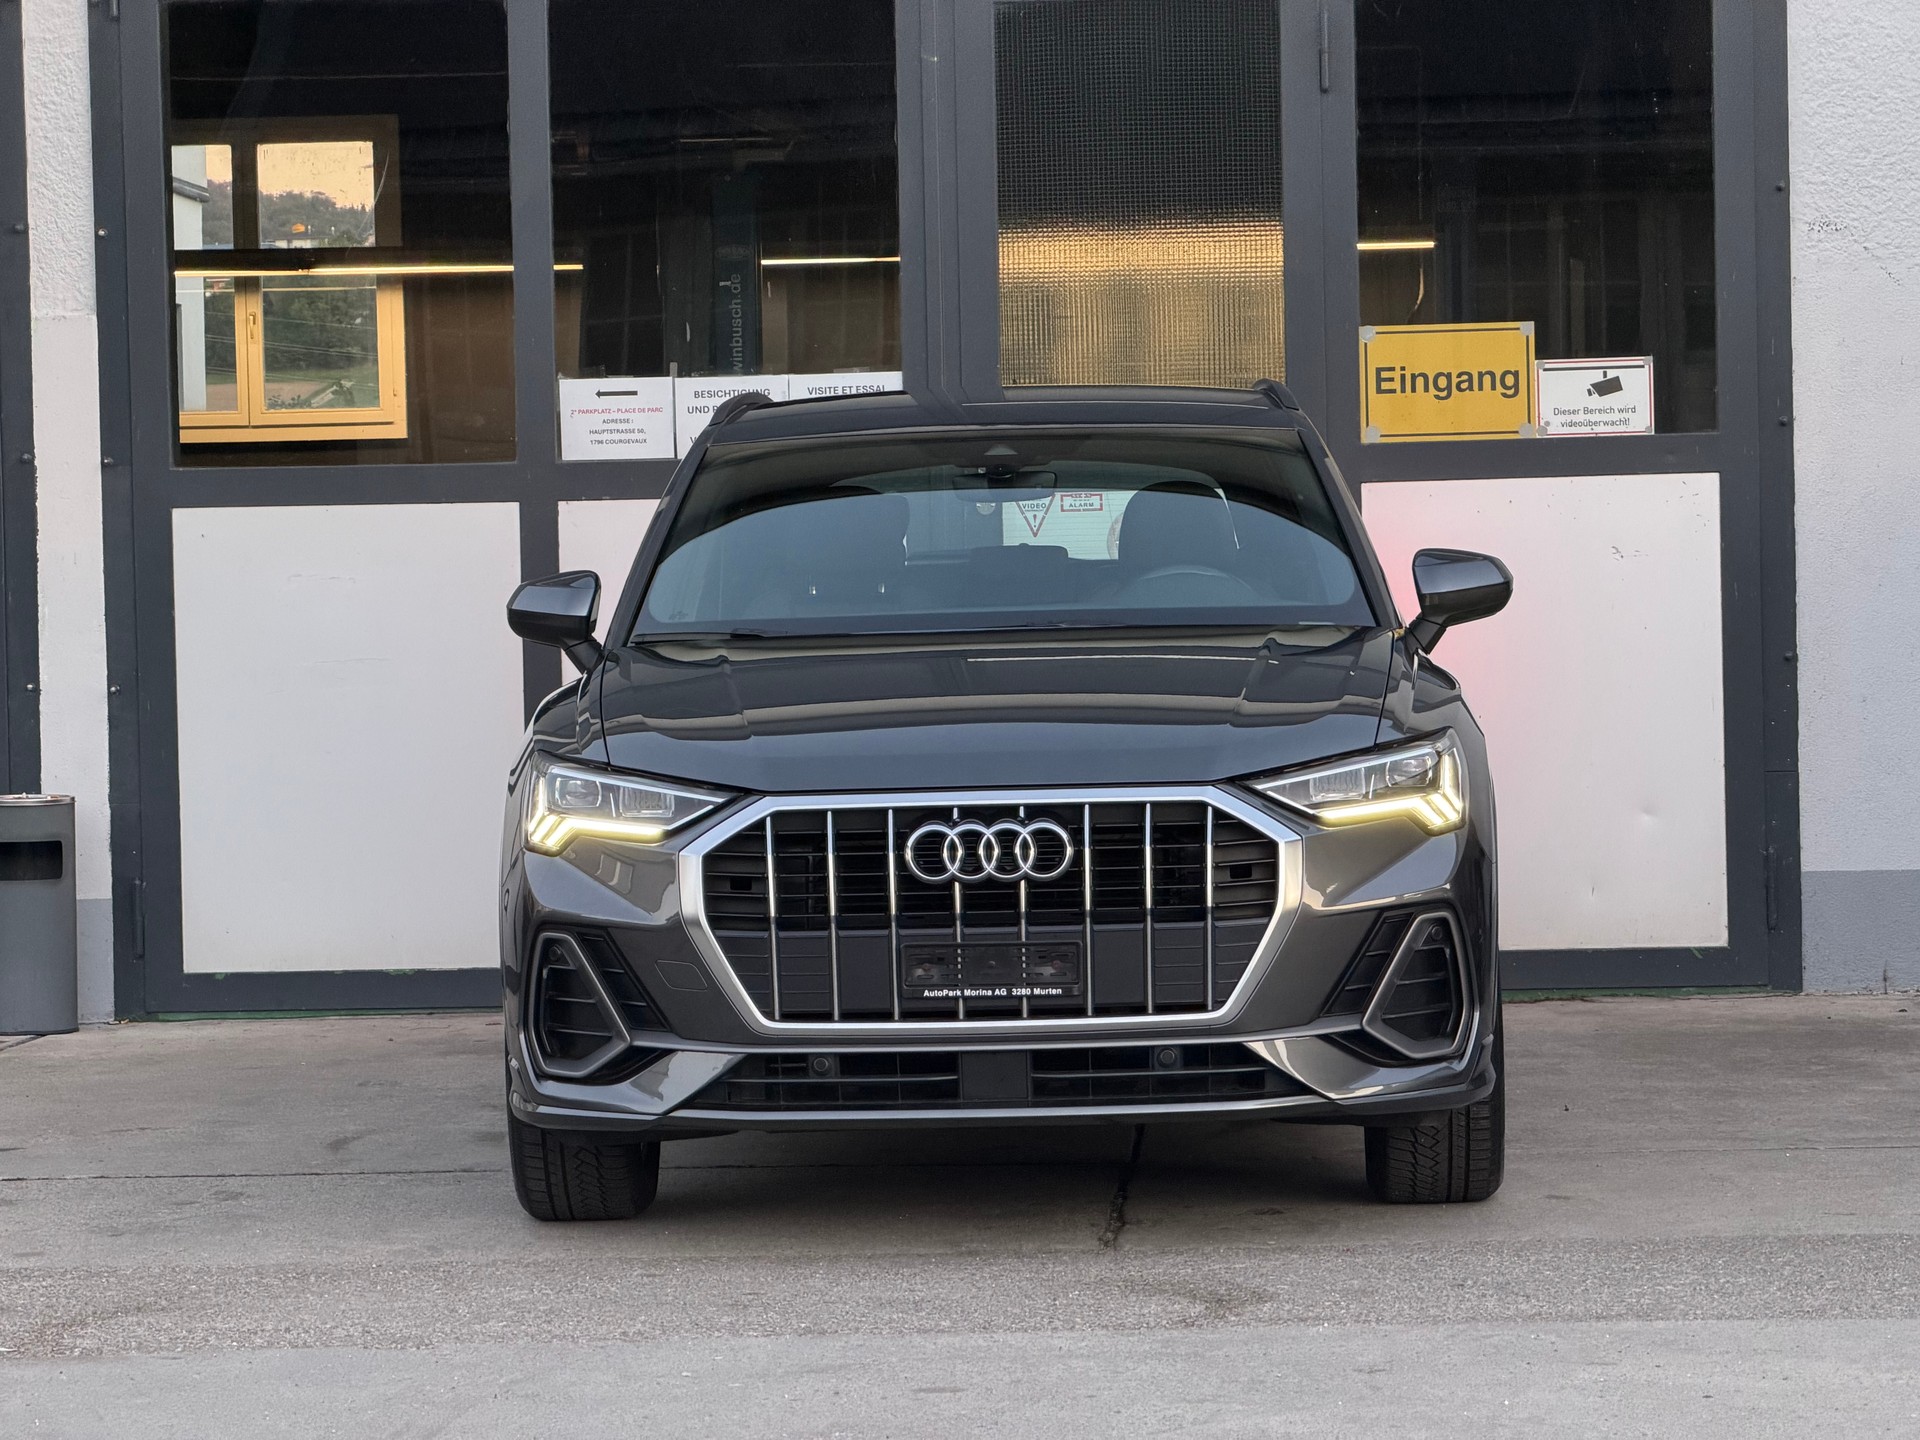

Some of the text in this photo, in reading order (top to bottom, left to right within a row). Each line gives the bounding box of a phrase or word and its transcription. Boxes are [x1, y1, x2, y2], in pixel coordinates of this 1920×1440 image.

[1375, 365, 1520, 401] Eingang
[807, 385, 885, 395] VISITE ET ESSAI
[687, 405, 710, 414] UND
[1553, 405, 1636, 416] Dieser Bereich wird
[1560, 417, 1630, 428] videoüberwacht!
[1021, 502, 1047, 510] VIDEO
[923, 987, 1062, 997] AutoPark Morina AG 3280 Murten
